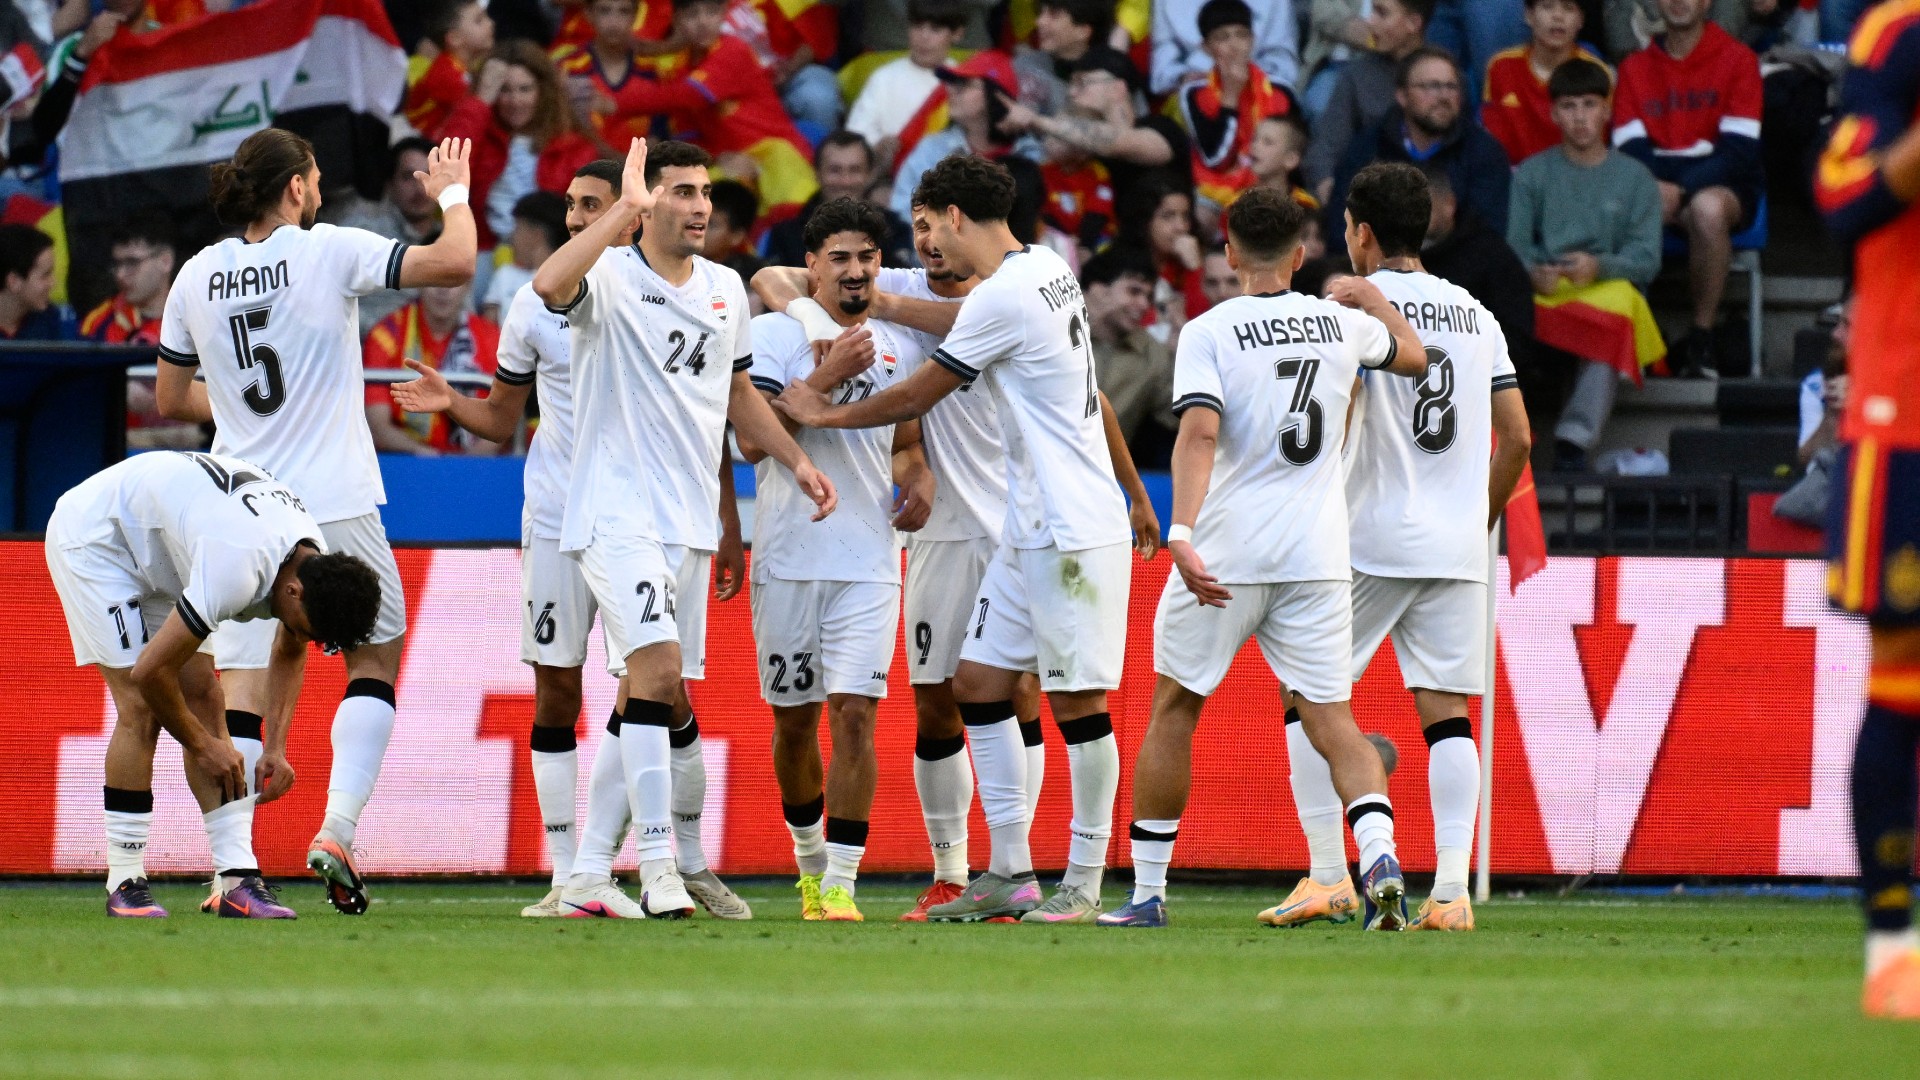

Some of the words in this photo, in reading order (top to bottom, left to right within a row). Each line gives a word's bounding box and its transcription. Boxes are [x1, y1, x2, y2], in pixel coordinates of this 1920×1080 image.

[208, 260, 289, 301] AKAM
[641, 294, 665, 305] JAKO
[1233, 315, 1343, 350] HUSSEIN
[229, 305, 286, 417] 5
[663, 329, 709, 376] 24
[1274, 357, 1325, 466] 3
[1412, 345, 1458, 454] 8
[915, 620, 932, 665] 9
[768, 652, 814, 694] 23
[871, 671, 888, 681] JAK
[546, 824, 567, 834] AKO
[643, 826, 672, 835] JAKO
[680, 813, 700, 823] JAK
[121, 842, 146, 850] JAK
